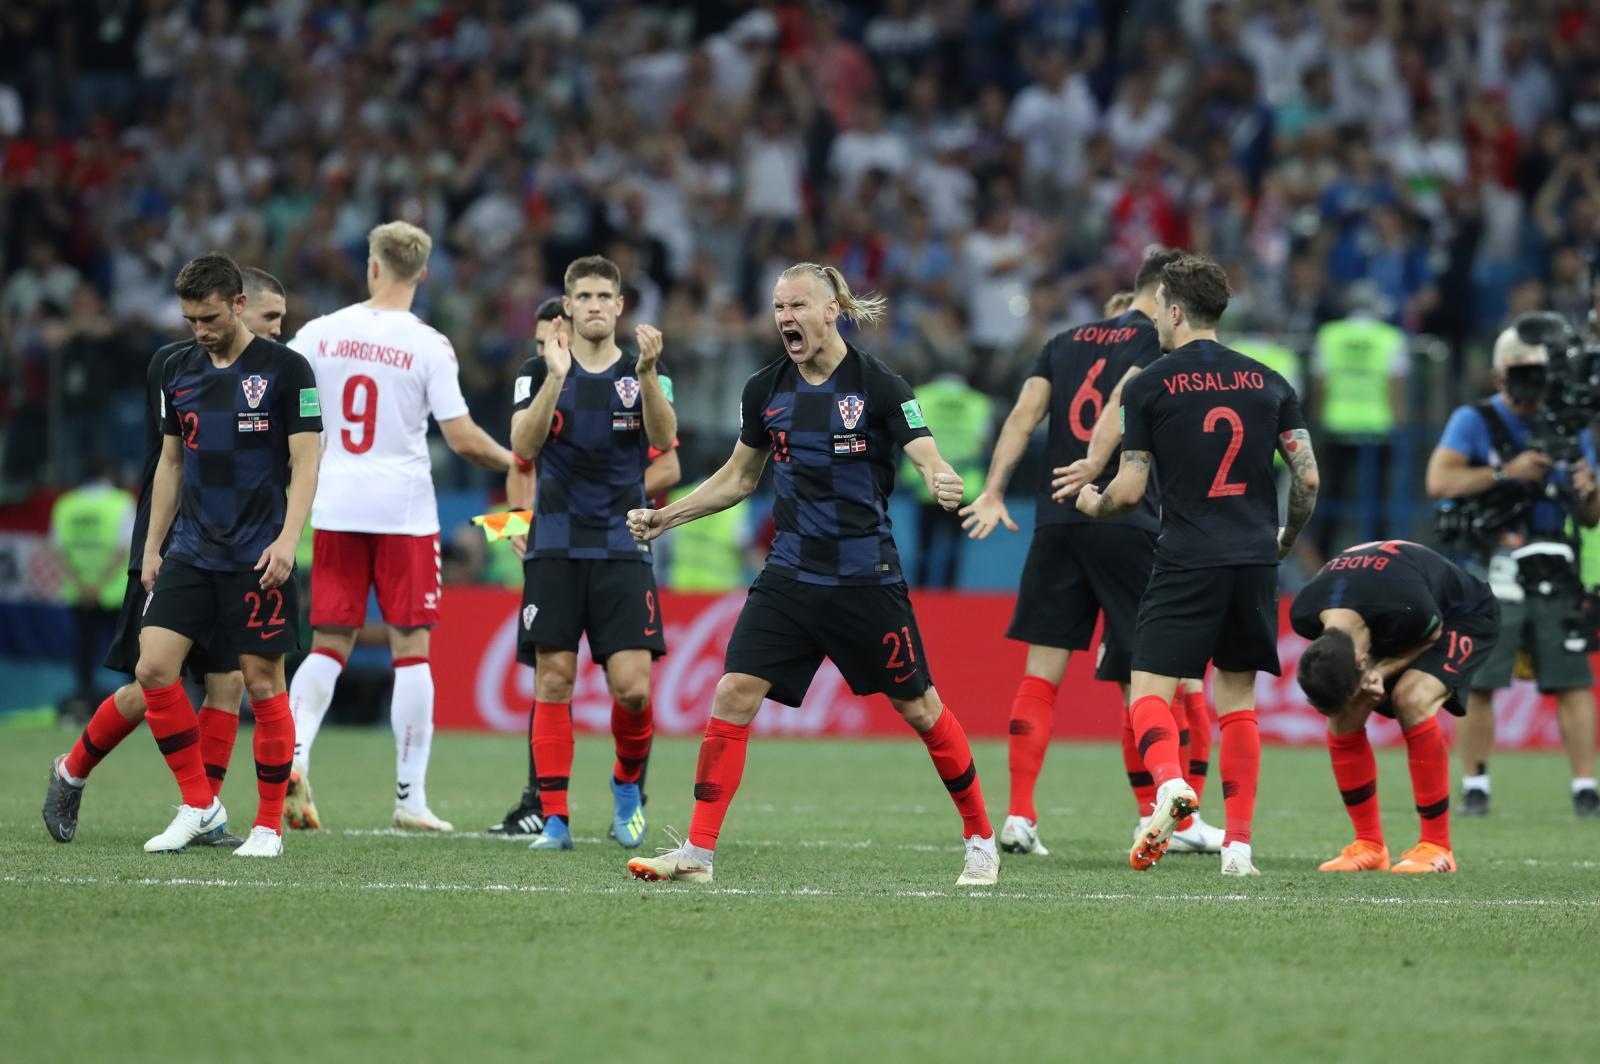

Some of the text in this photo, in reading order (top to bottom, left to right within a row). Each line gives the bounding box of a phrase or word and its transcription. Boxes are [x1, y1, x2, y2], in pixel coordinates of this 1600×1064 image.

[1073, 326, 1137, 345] LOVREN
[331, 340, 413, 370] JØRGENSEN
[1069, 358, 1107, 441] 6
[1163, 371, 1264, 395] VRSALJKO
[341, 374, 378, 454] 9
[1203, 406, 1247, 498] 2
[1329, 556, 1390, 571] BADEL
[244, 589, 286, 627] 22
[646, 590, 654, 624] 9
[882, 626, 915, 669] 21
[1447, 630, 1472, 665] 19
